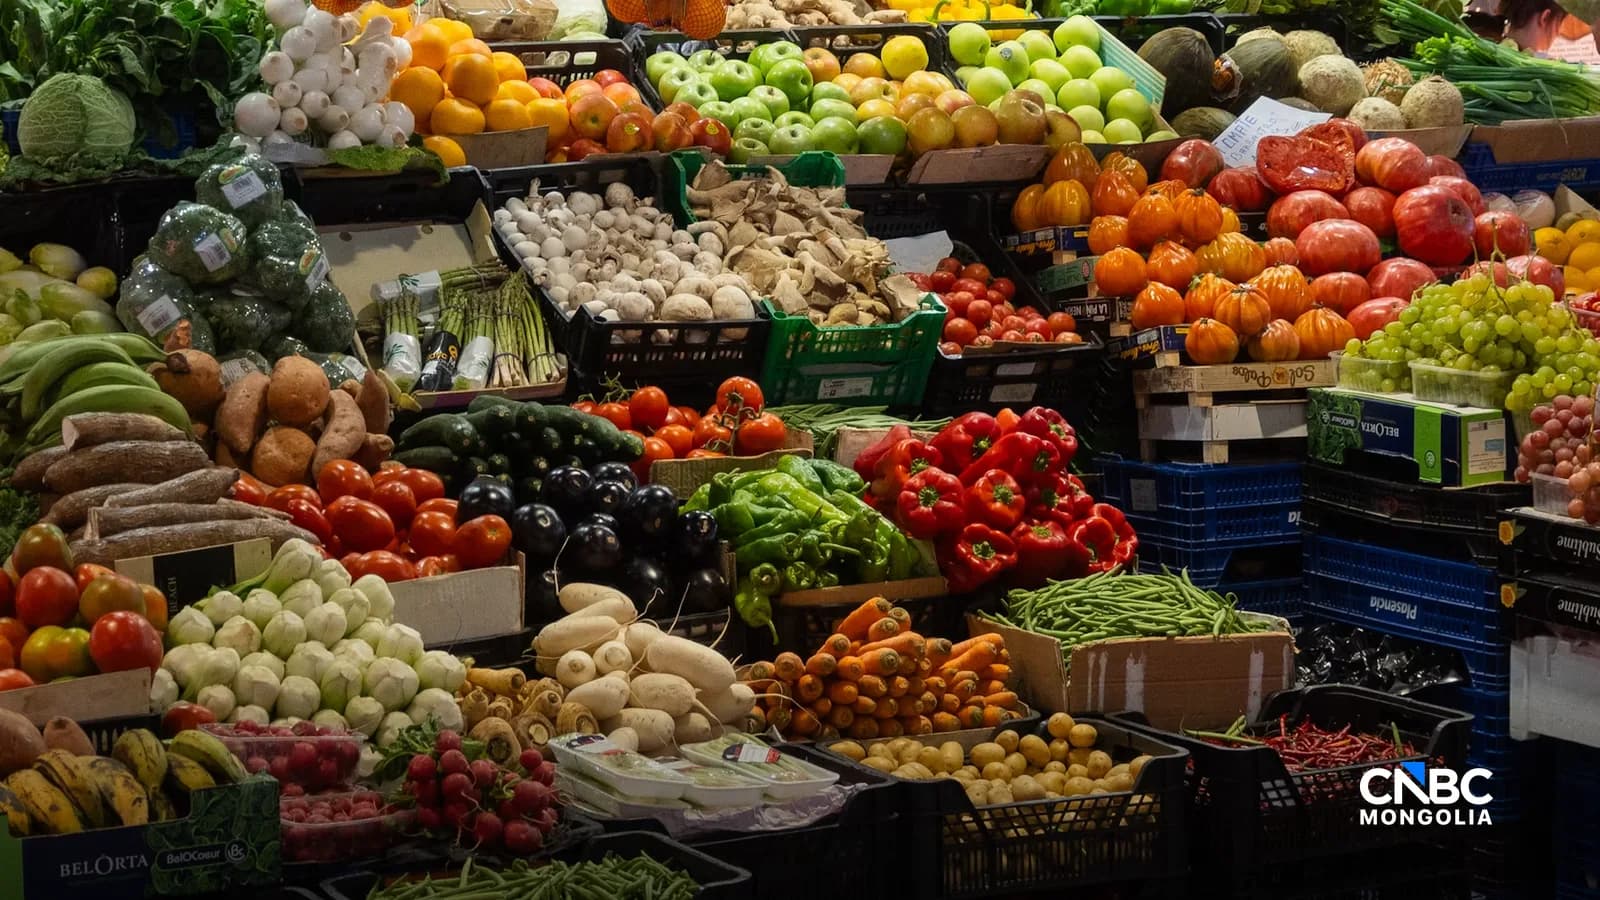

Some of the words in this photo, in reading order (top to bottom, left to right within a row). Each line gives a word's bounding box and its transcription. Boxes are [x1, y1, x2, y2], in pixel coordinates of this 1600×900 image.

[1289, 365, 1316, 387] Sol
[1361, 421, 1400, 437] BELORTA
[1369, 595, 1417, 620] Plasencia
[60, 853, 149, 878] BELORTA
